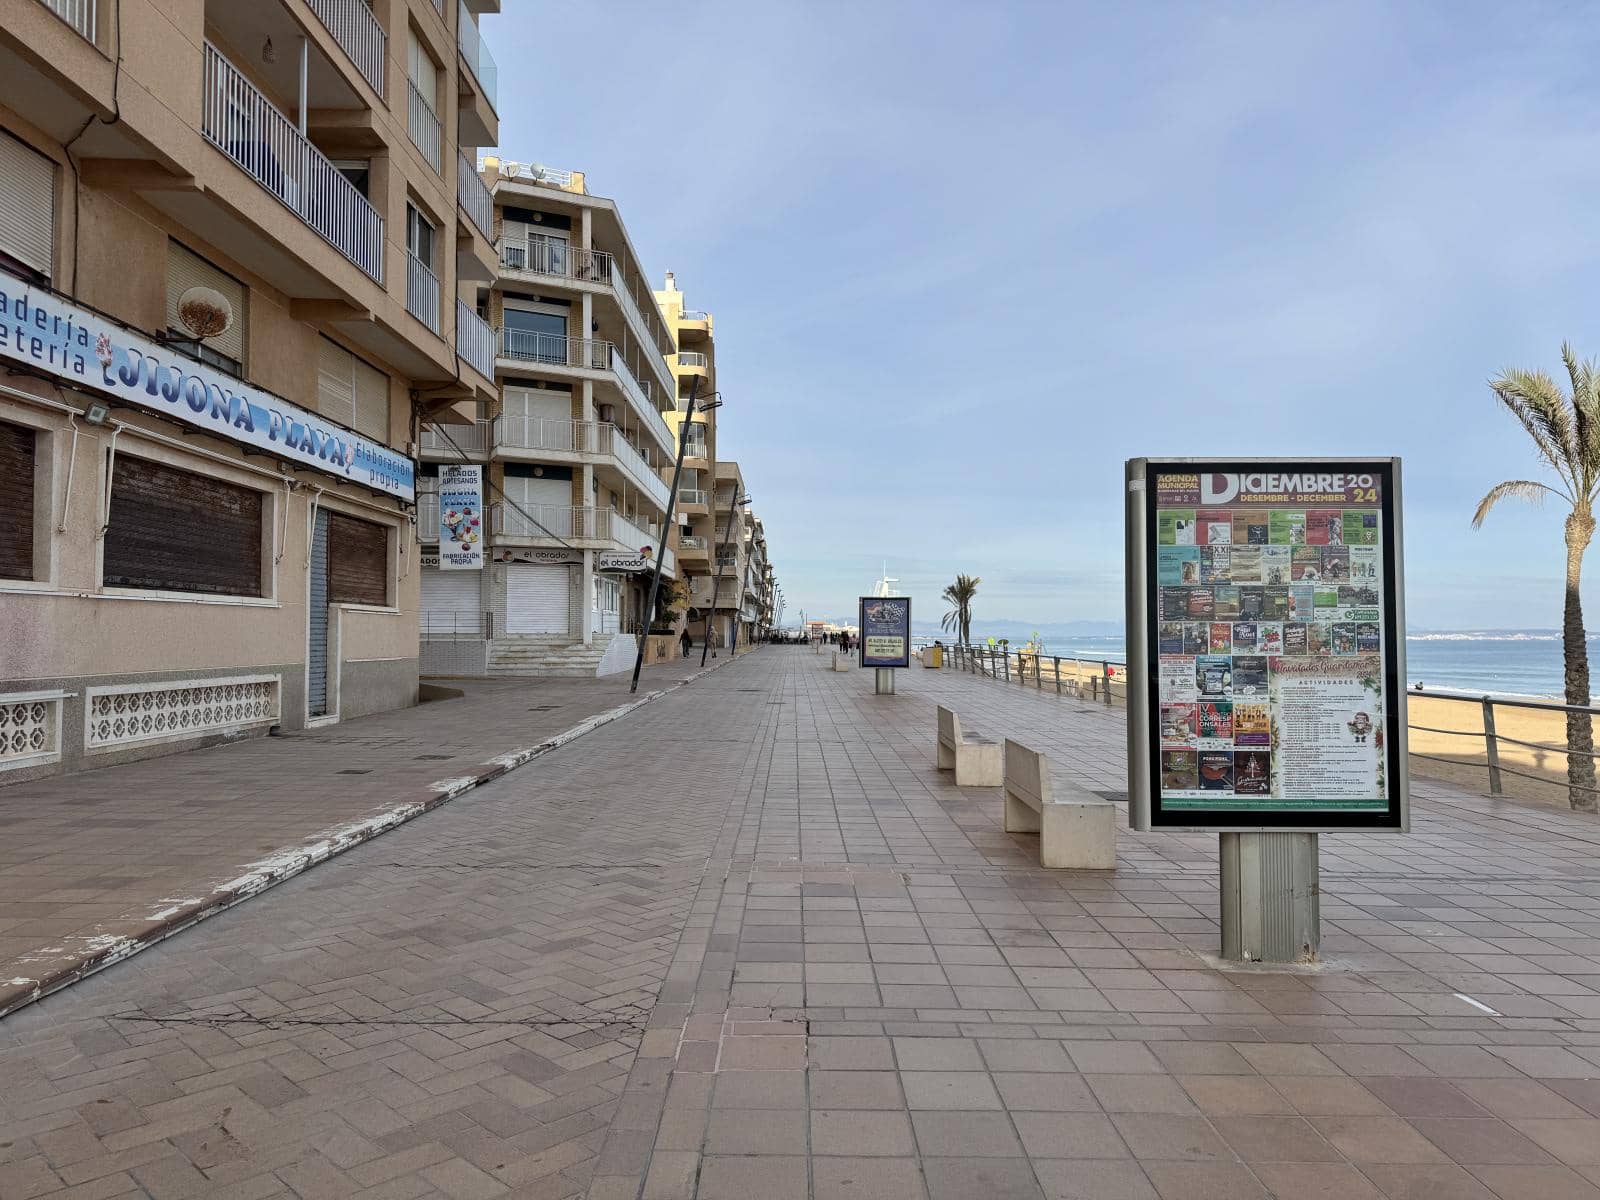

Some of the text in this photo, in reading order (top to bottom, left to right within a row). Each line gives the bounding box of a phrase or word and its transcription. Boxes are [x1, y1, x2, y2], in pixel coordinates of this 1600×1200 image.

[0, 291, 88, 347] adería
[0, 324, 85, 376] etería
[119, 348, 345, 467] JIJONA PLAYA
[356, 442, 410, 475] Elaboración
[369, 469, 399, 489] propia
[1158, 474, 1198, 482] AGENDA
[1346, 474, 1373, 488] 20
[1240, 494, 1290, 502] DESEMBRE
[1297, 494, 1346, 502] DECEMBER
[1353, 488, 1378, 503] 24
[611, 558, 645, 567] obrador
